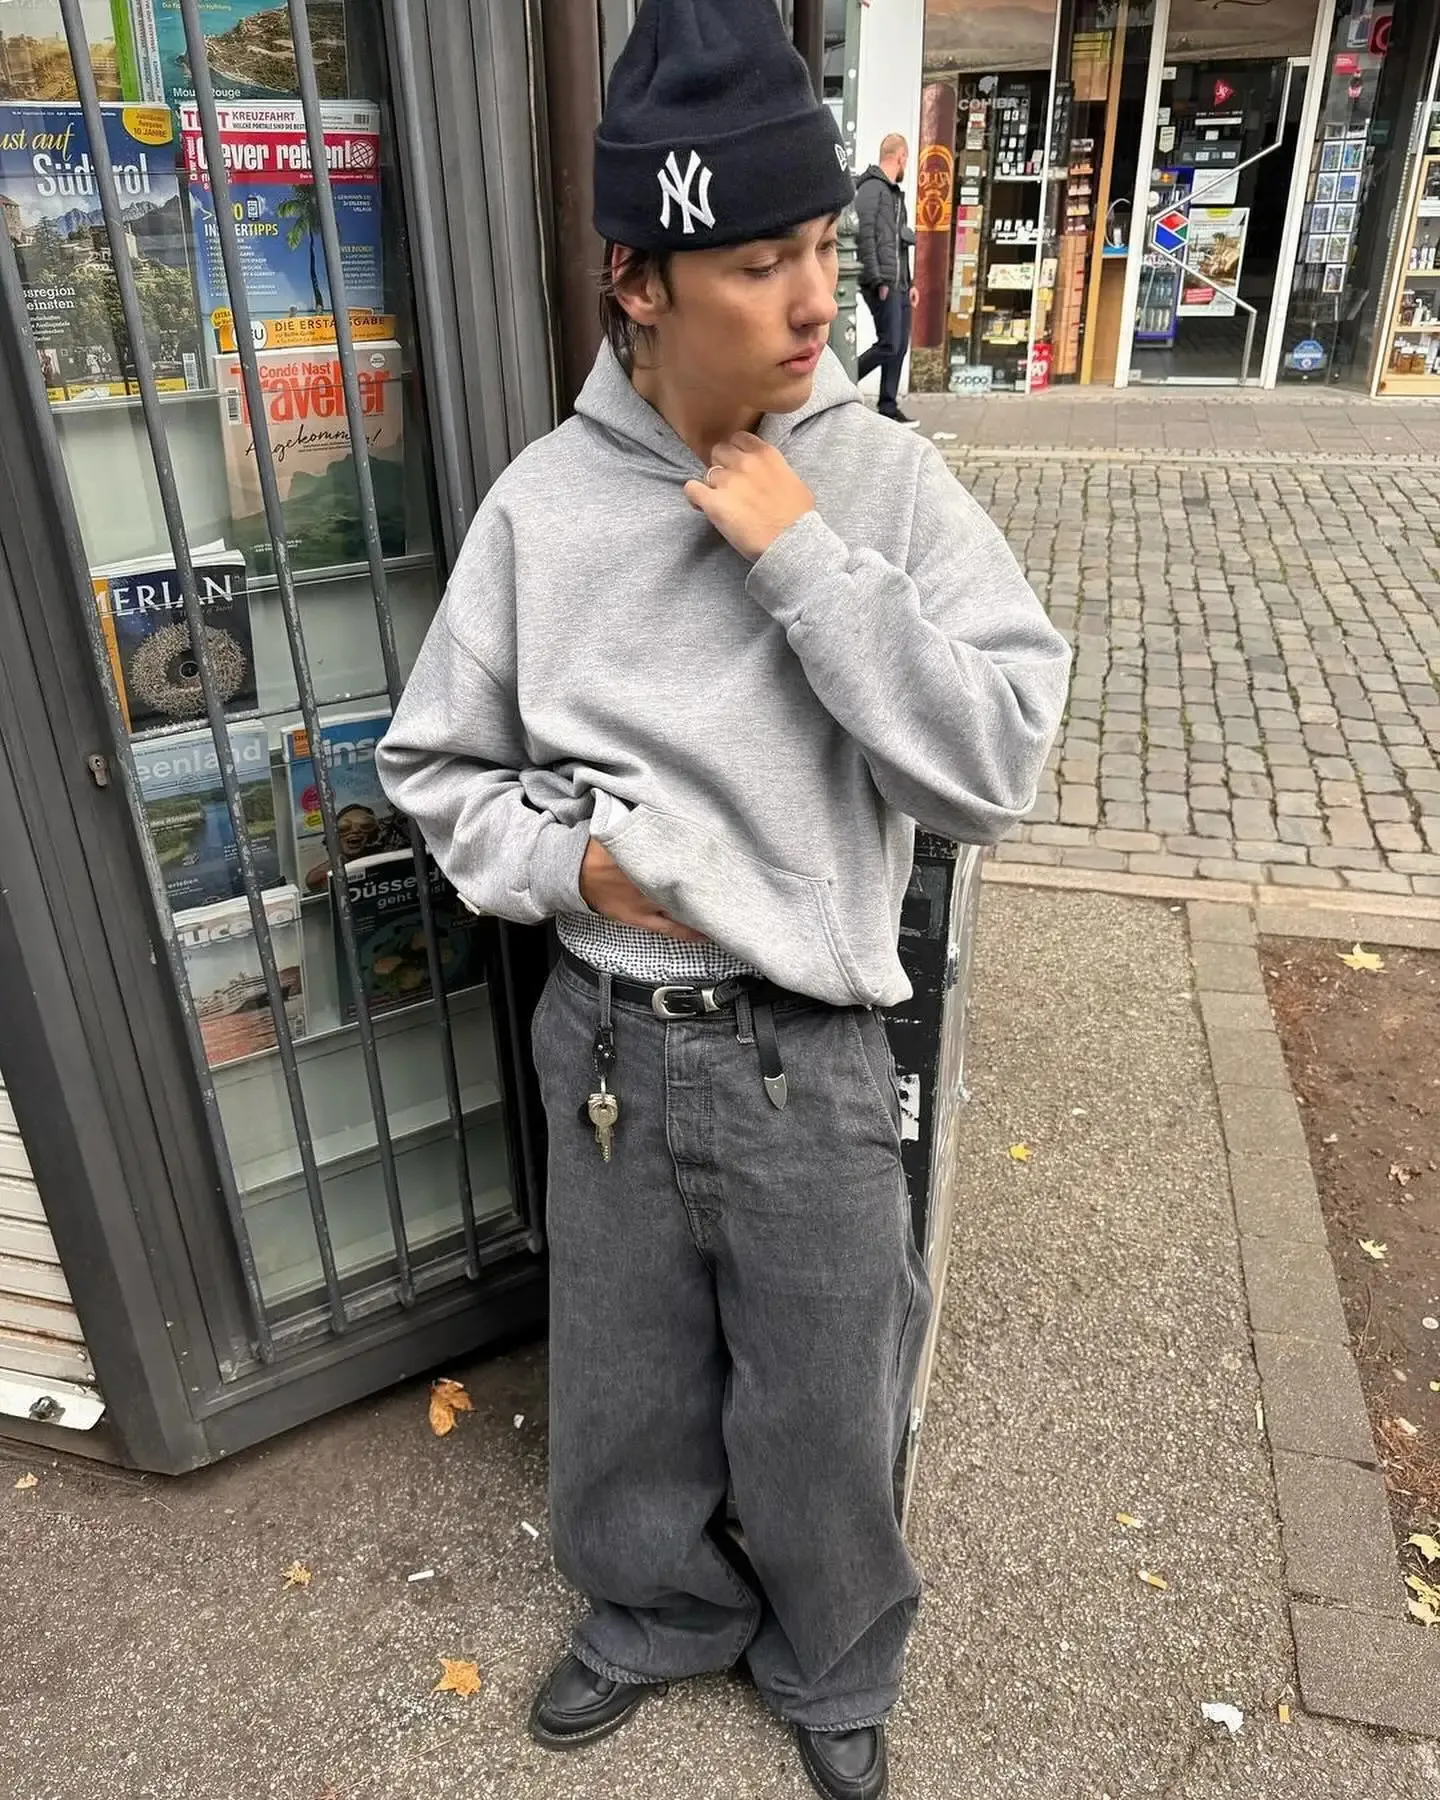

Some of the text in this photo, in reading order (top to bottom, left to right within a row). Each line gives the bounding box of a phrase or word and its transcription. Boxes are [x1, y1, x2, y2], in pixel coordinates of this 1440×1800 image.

[172, 87, 198, 97] Mou
[958, 96, 1021, 111] COHIBA
[183, 110, 296, 129] TT KREUZFAHRT
[0, 122, 75, 162] ust auf
[196, 137, 351, 171] Cever reien!
[32, 153, 151, 197] Südrol
[657, 150, 716, 234] NY
[204, 223, 280, 237] INERTIPPS
[26, 299, 76, 312] einsten
[274, 321, 294, 332] DIE
[299, 317, 385, 330] ERSTAGABE
[259, 360, 332, 379] Condé Nast
[953, 374, 990, 386] zippo
[230, 360, 392, 425] Traveler
[245, 424, 383, 463] Agekomm!
[95, 574, 234, 619] ERIN
[137, 738, 262, 783] eenlad
[348, 867, 446, 903] Düssed
[377, 891, 413, 910] geht
